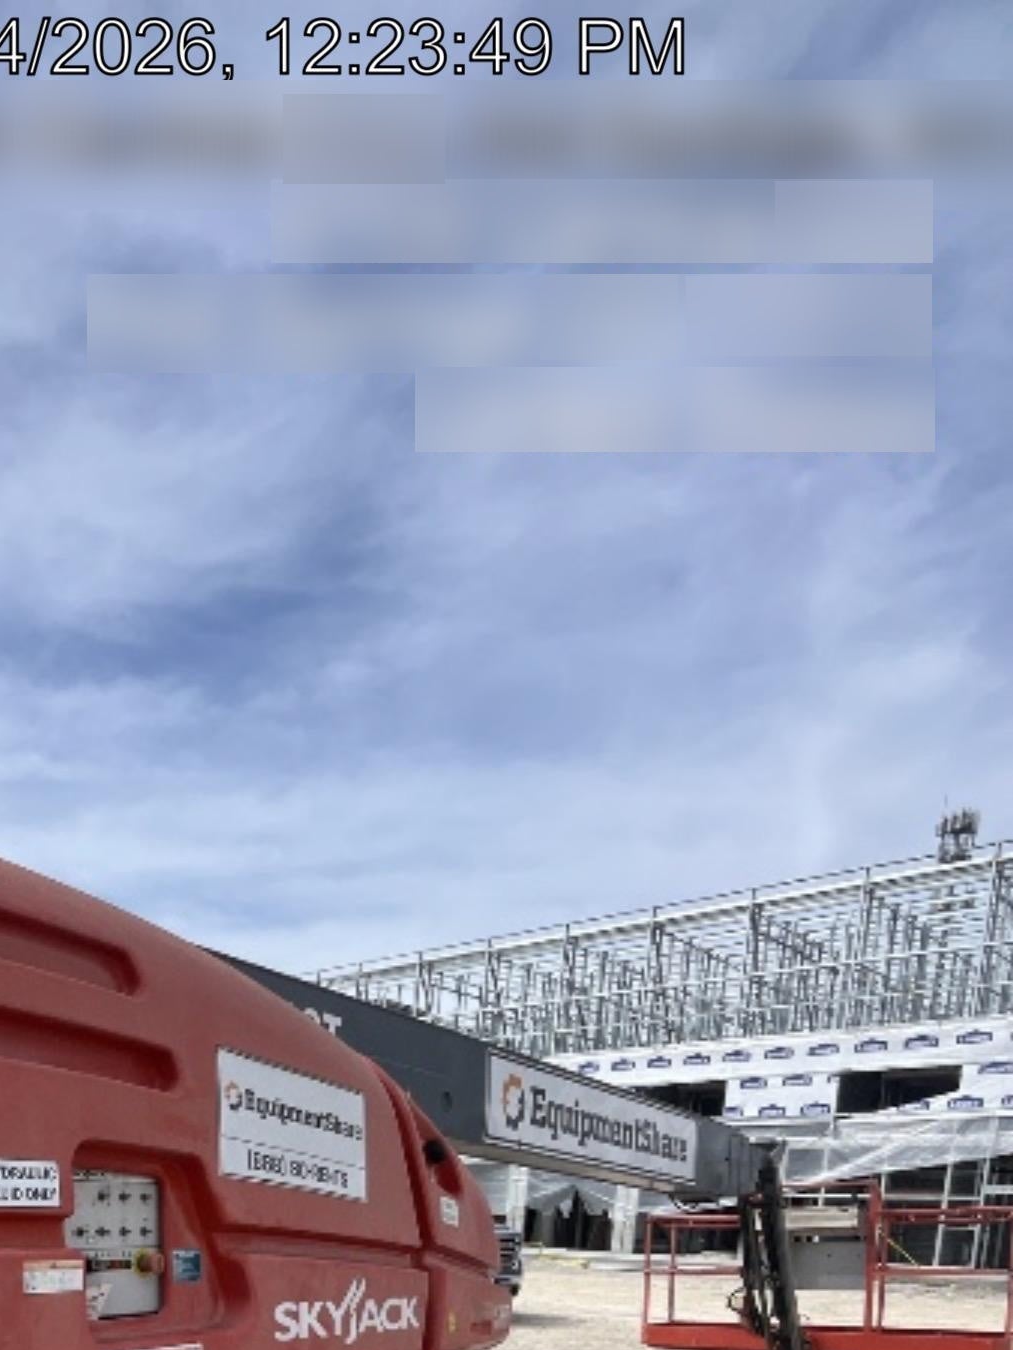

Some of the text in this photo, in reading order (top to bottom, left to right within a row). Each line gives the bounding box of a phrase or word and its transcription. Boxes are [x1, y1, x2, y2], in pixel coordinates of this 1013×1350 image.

[244, 1088, 363, 1141] EquipmentShare
[529, 1085, 687, 1162] EquipmentShare
[274, 1278, 420, 1344] SKYJACK
